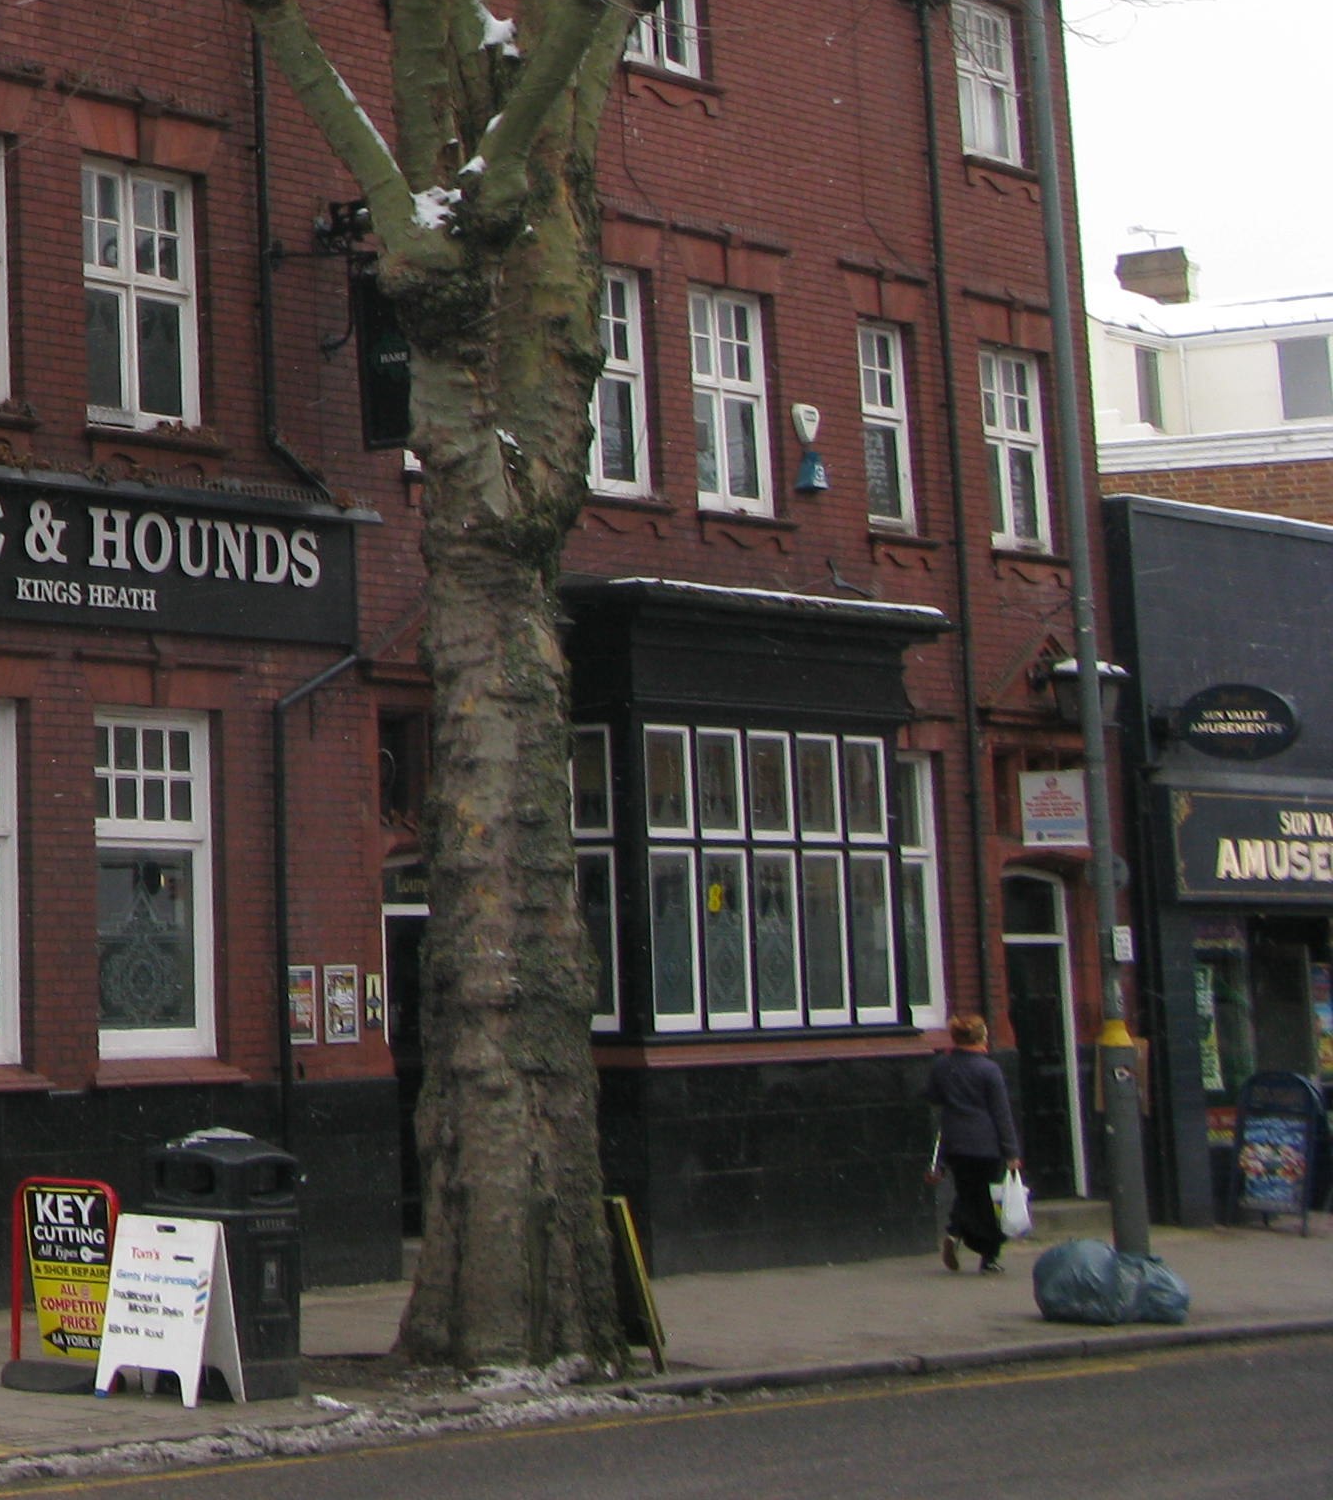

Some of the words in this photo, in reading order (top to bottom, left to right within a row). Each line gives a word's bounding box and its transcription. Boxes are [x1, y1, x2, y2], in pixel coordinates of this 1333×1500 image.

[24, 500, 68, 564] &
[88, 506, 321, 588] HOUNDS
[16, 577, 82, 606] KINGS
[88, 584, 157, 612] HEATH
[1226, 710, 1268, 720] VALLEY
[1190, 721, 1285, 735] AMUSEMENTS
[1279, 811, 1312, 836] SUN
[35, 1192, 96, 1226] KEY
[34, 1224, 105, 1245] CUTTING
[131, 1246, 161, 1261] Tom's
[43, 1264, 69, 1276] SHOE
[60, 1283, 78, 1297] ALL
[60, 1315, 98, 1331] PRICES
[65, 1334, 91, 1348] YORK
